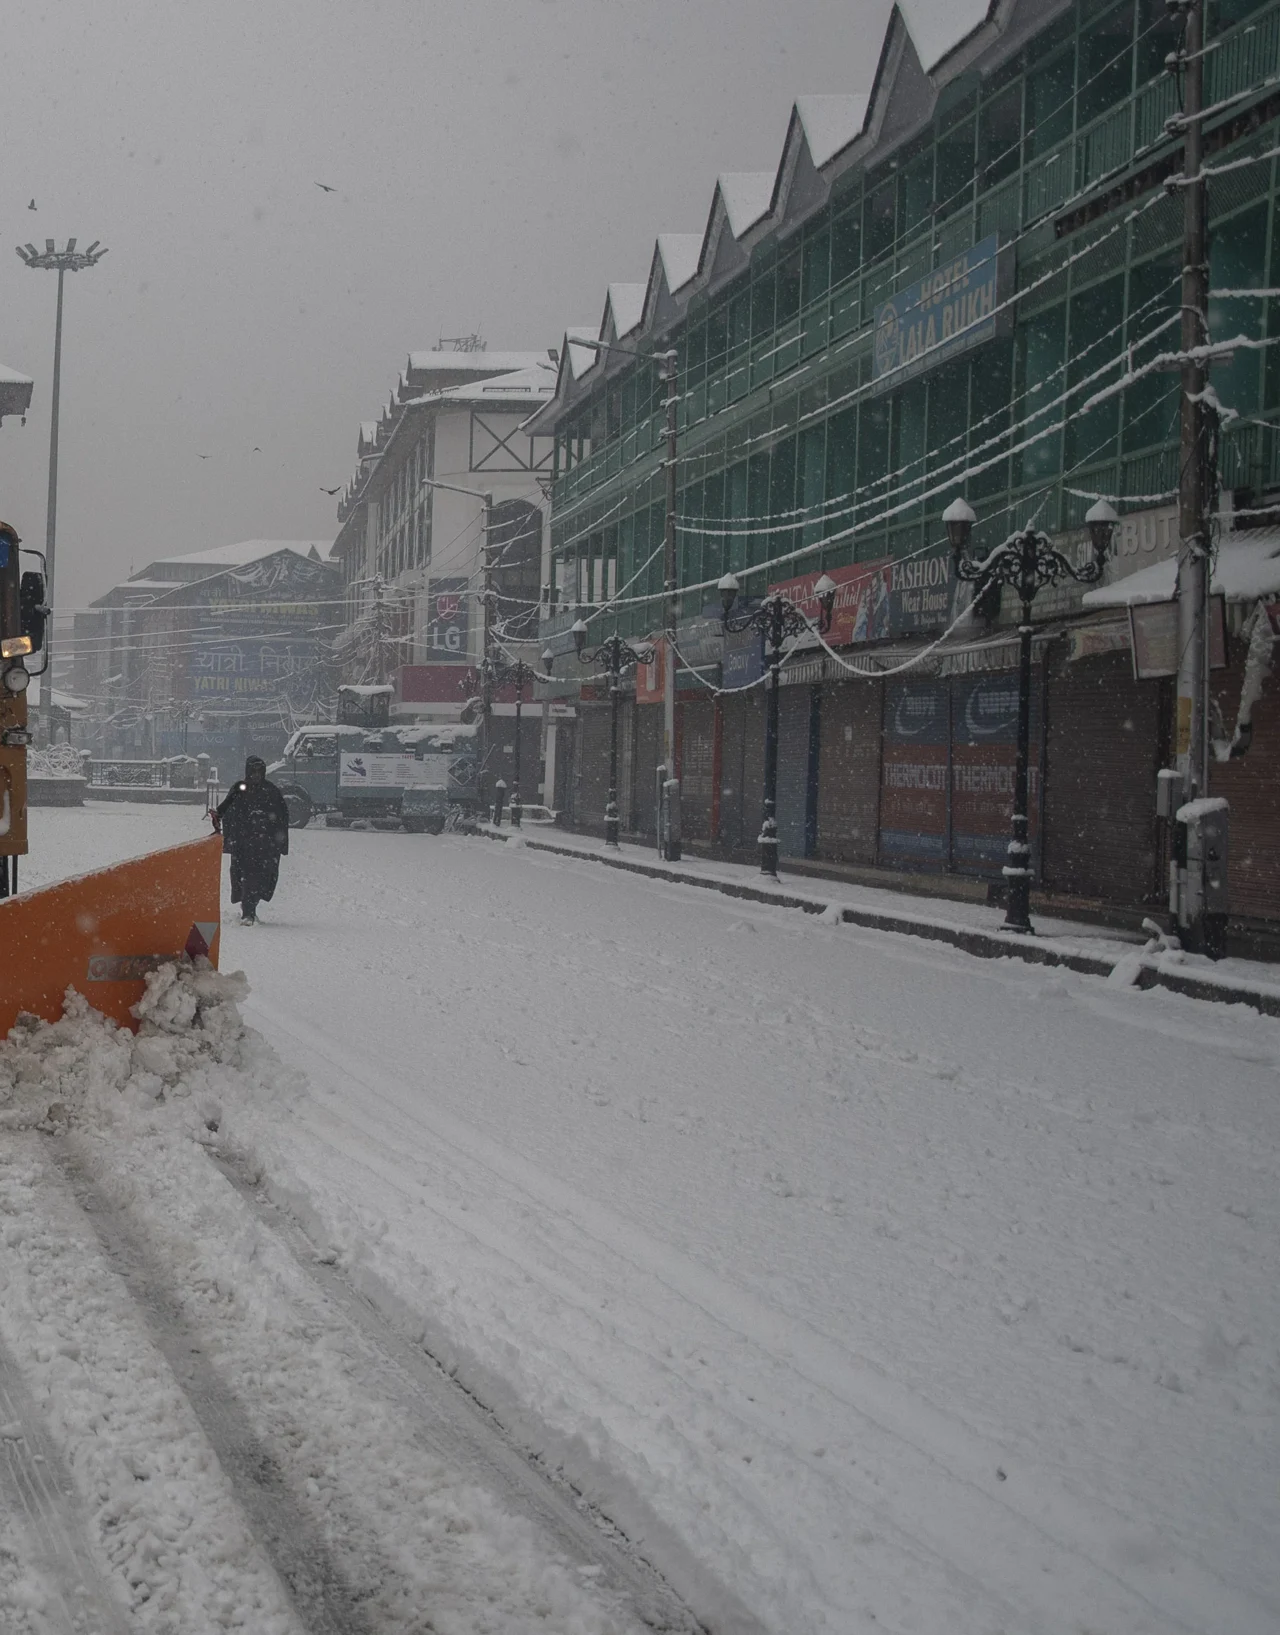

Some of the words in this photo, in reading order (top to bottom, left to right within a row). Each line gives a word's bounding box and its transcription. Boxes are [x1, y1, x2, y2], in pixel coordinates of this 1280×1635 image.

[920, 256, 969, 312] HOTEL
[941, 280, 993, 341] RUKH
[890, 555, 950, 593] FASHION
[901, 591, 921, 613] Wear
[922, 589, 948, 611] House
[433, 626, 460, 650] LG
[193, 676, 229, 691] YATRI
[252, 733, 280, 744] Galaxy
